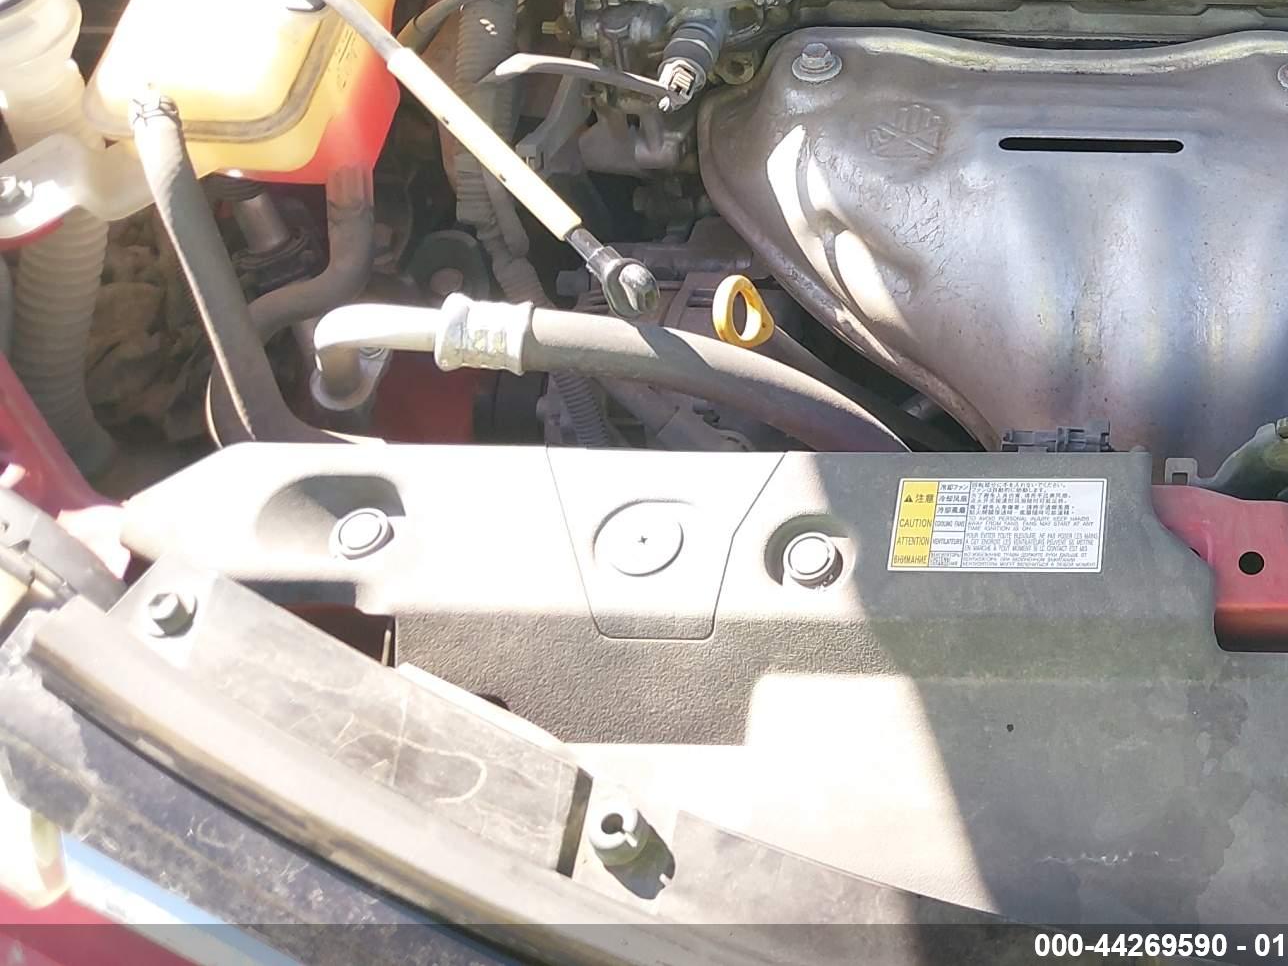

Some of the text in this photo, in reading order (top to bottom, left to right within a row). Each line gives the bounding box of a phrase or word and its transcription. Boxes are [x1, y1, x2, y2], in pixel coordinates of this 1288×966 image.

[915, 493, 934, 504] 注意
[899, 518, 932, 528] CAUTION
[896, 537, 930, 547] ATTENTION
[893, 554, 928, 565] ВНИМАНИЕ
